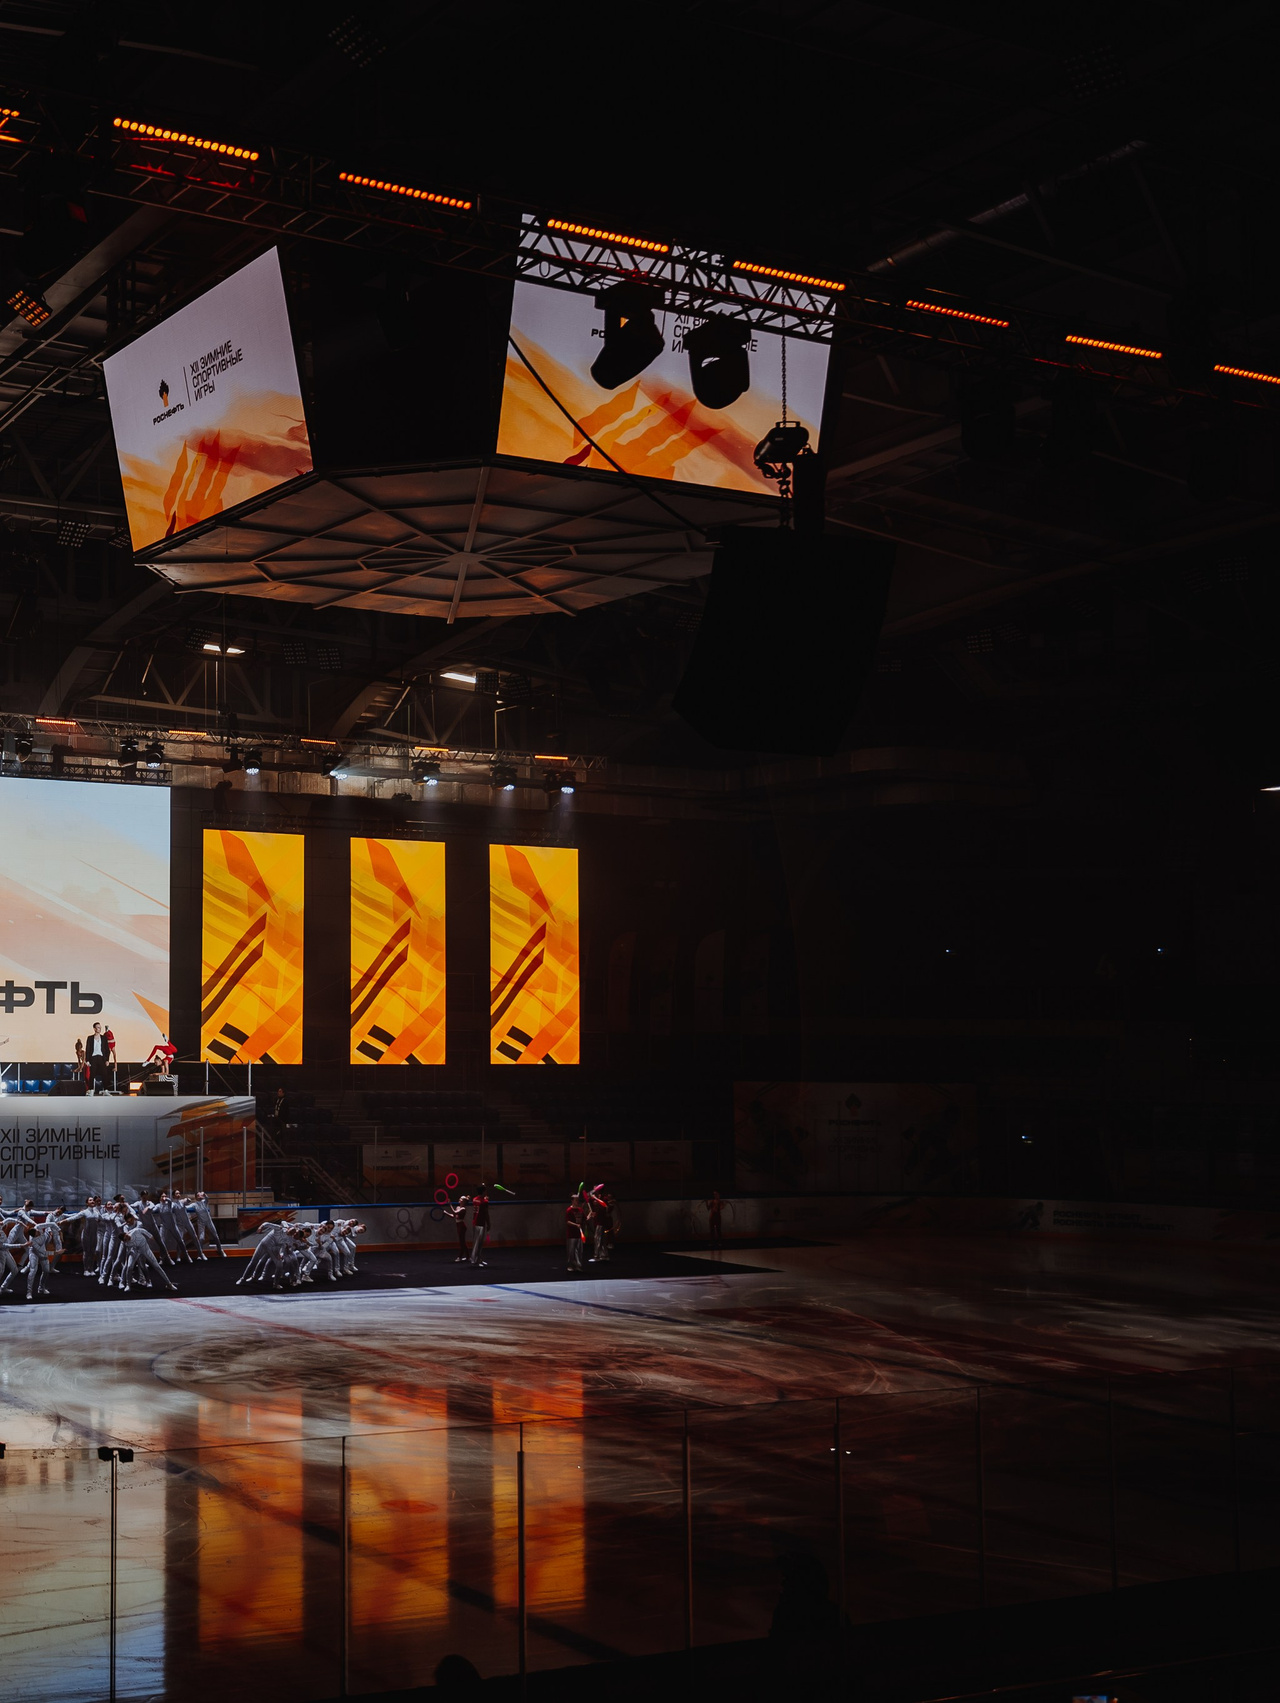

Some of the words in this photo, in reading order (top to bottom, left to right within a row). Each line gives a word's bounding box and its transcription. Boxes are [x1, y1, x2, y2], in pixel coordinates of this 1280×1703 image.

[190, 360, 200, 376] XII
[200, 340, 233, 369] ЗИМНИЕ
[192, 348, 243, 388] СПОРТИВНЫЕ
[194, 380, 216, 402] ИГРЫ
[152, 403, 185, 426] РОСНЕФТЬ
[0, 1128, 21, 1144] XII
[25, 1127, 101, 1144] ЗИМНИЕ
[0, 1144, 120, 1161] СПОРТИВНЫЕ
[0, 1163, 49, 1179] ИГРЫ
